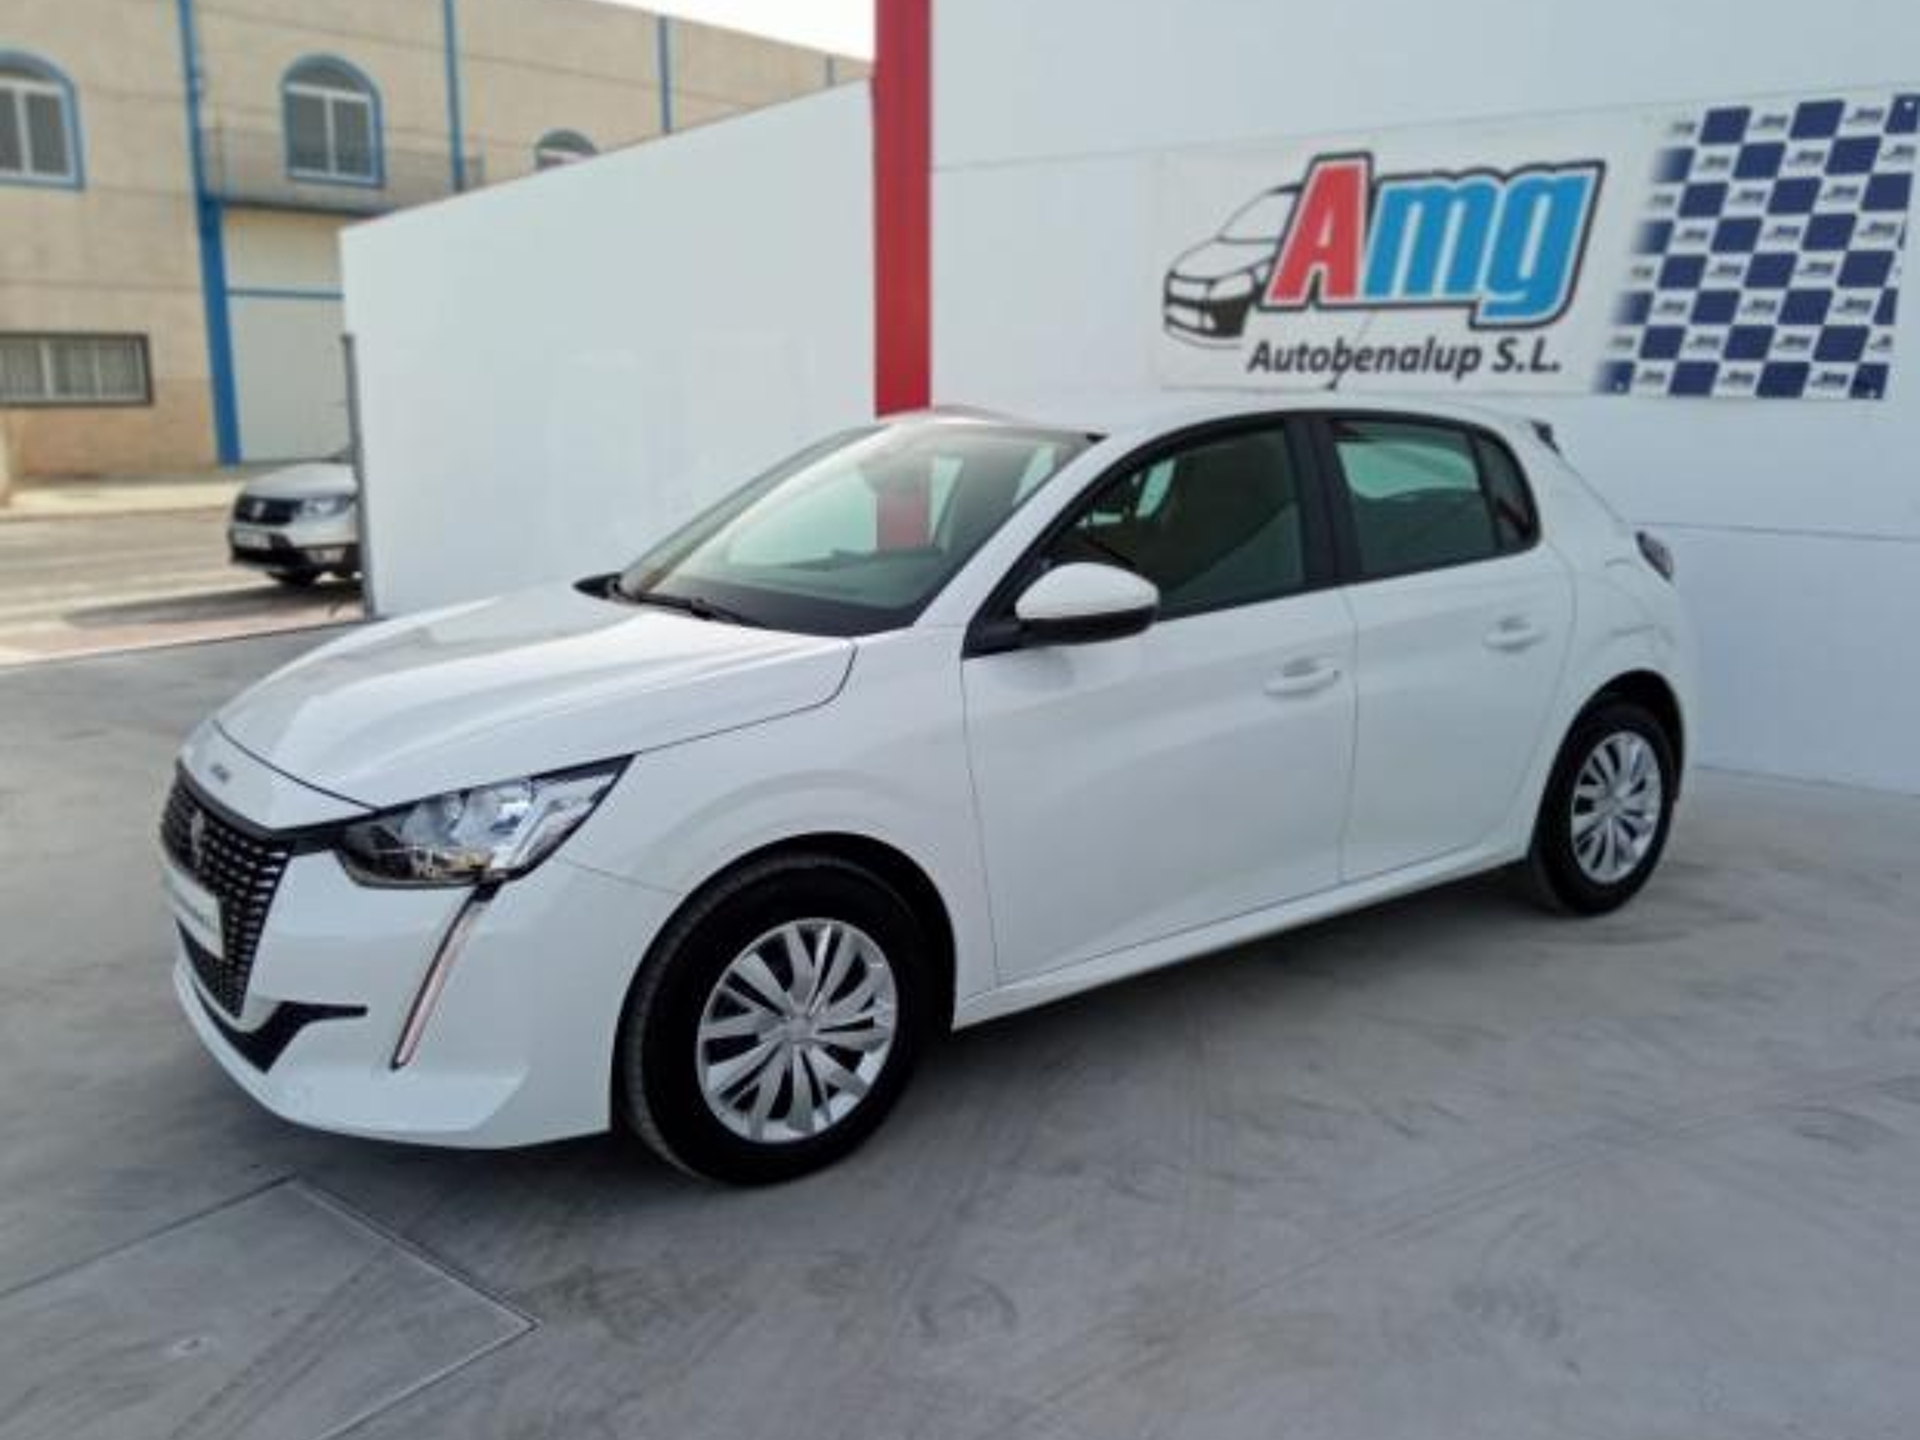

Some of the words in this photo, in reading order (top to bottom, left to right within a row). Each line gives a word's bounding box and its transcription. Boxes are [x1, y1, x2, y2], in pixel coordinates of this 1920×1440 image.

[1258, 152, 1604, 329] Amg
[1246, 336, 1483, 381] Autobenalup
[1491, 337, 1562, 373] S.L.
